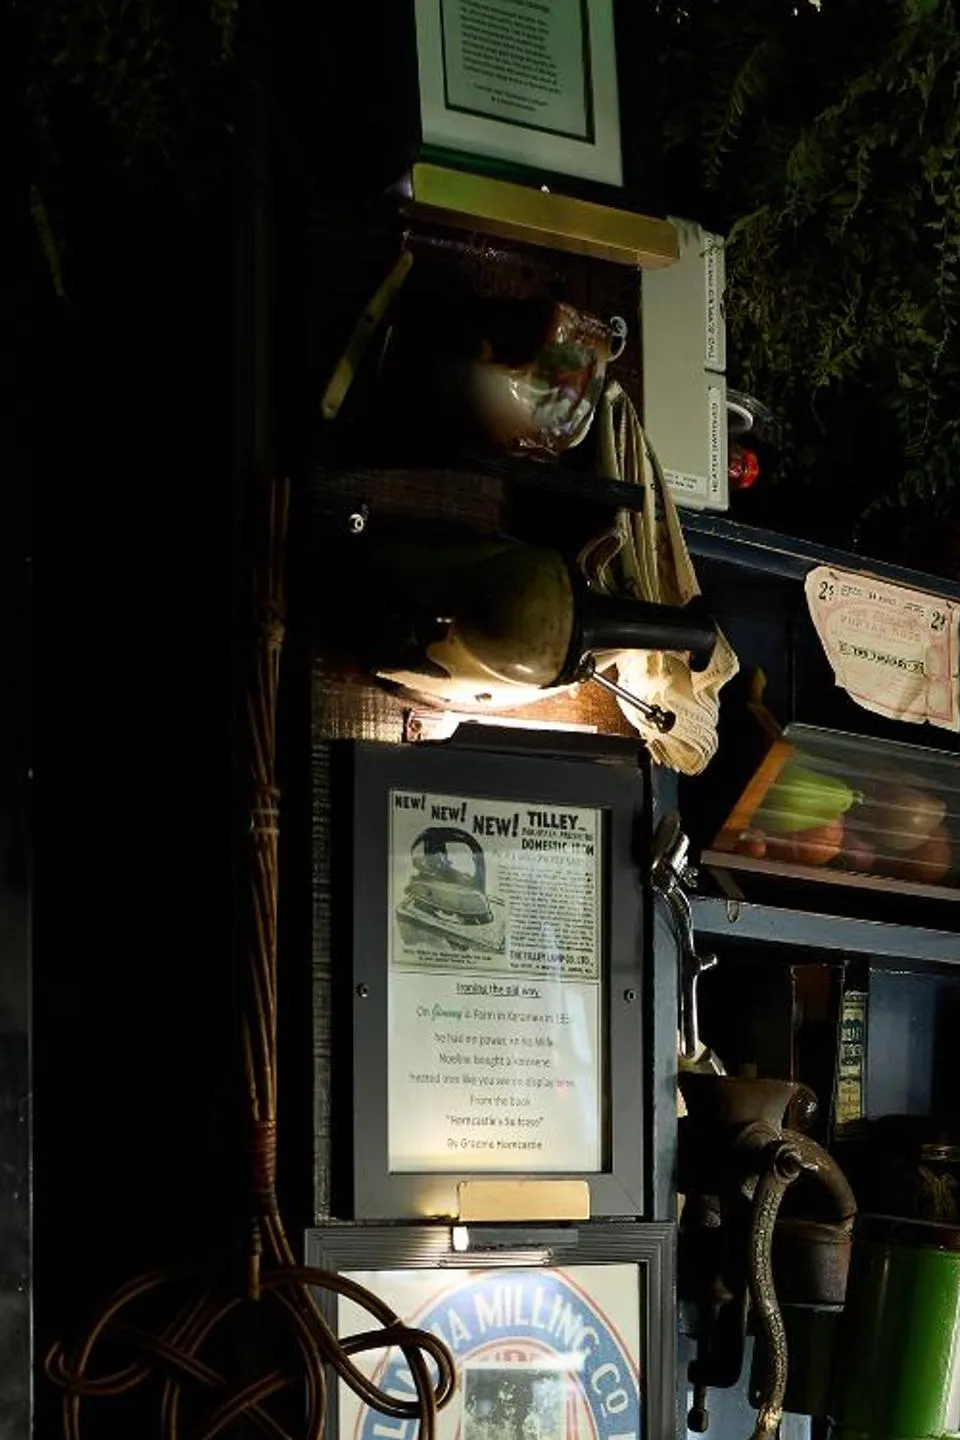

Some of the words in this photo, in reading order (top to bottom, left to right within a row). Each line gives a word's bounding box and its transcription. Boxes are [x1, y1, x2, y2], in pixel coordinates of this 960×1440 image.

[394, 795, 426, 811] NEW!
[431, 802, 467, 823] NEW!
[472, 813, 520, 838] NEW!
[527, 811, 579, 830] TILLEY
[473, 1283, 600, 1357] MILLING
